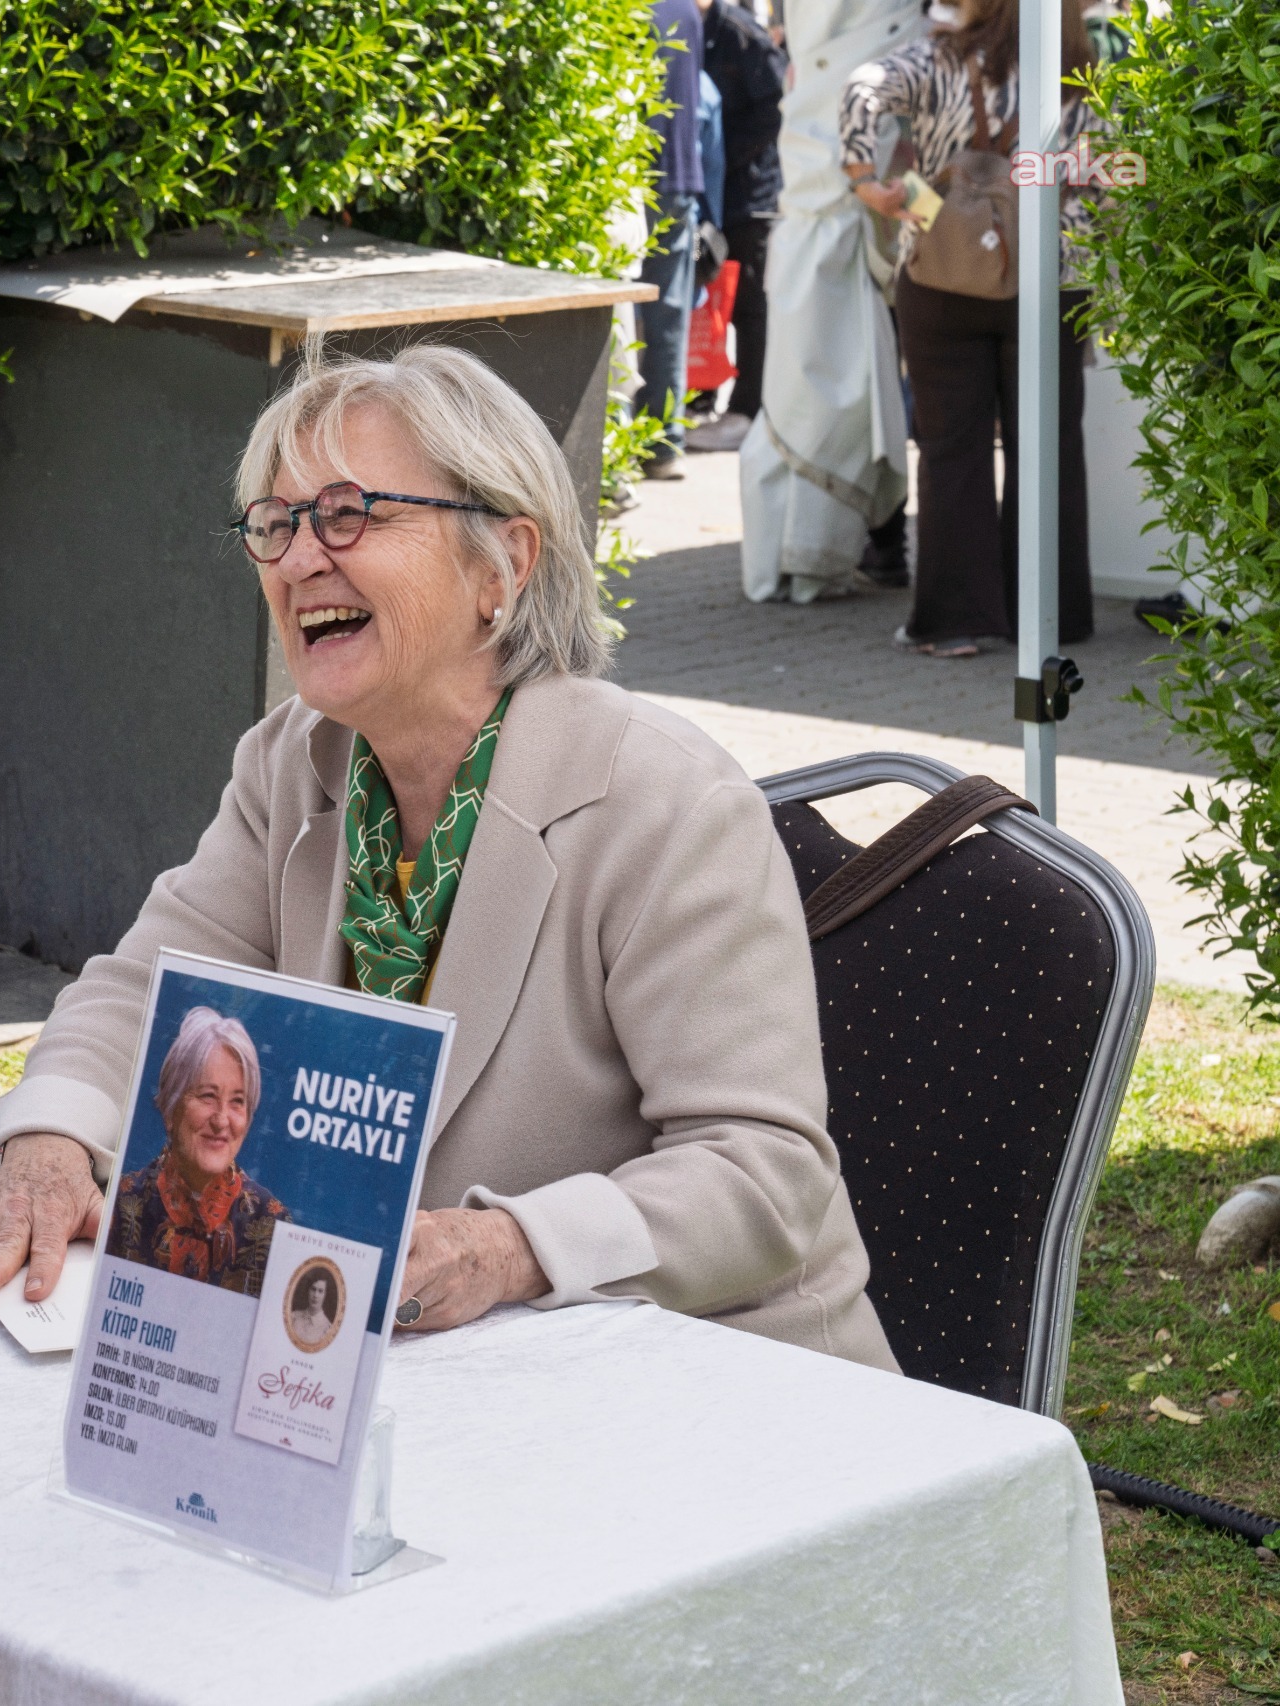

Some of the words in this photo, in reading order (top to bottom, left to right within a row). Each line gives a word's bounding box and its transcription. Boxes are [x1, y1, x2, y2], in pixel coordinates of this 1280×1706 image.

[293, 1066, 415, 1128] NURİYE
[287, 1107, 406, 1164] ORTAYLI
[108, 1270, 144, 1308] İZMİR
[101, 1306, 138, 1340] KİTAP
[138, 1320, 177, 1353] FUARI
[91, 1361, 137, 1390] KONFERANS:
[138, 1376, 160, 1397] 14.00
[96, 1341, 120, 1363] TARİH:
[131, 1350, 155, 1374] NİSAN
[155, 1360, 177, 1380] 2026
[176, 1366, 220, 1394] CUMARTESİ
[257, 1365, 335, 1411] Şefika
[83, 1398, 105, 1422] İMZA:
[106, 1408, 127, 1430] 15.00
[87, 1382, 115, 1404] SALON:
[115, 1387, 136, 1411] İLBER
[136, 1398, 166, 1421] ORTAYLI
[165, 1406, 218, 1438] KÜTÜPHANESİ
[80, 1422, 96, 1441] YER:
[97, 1425, 116, 1448] İMZA
[116, 1434, 138, 1455] ALANI
[175, 1496, 218, 1523] Kronik
